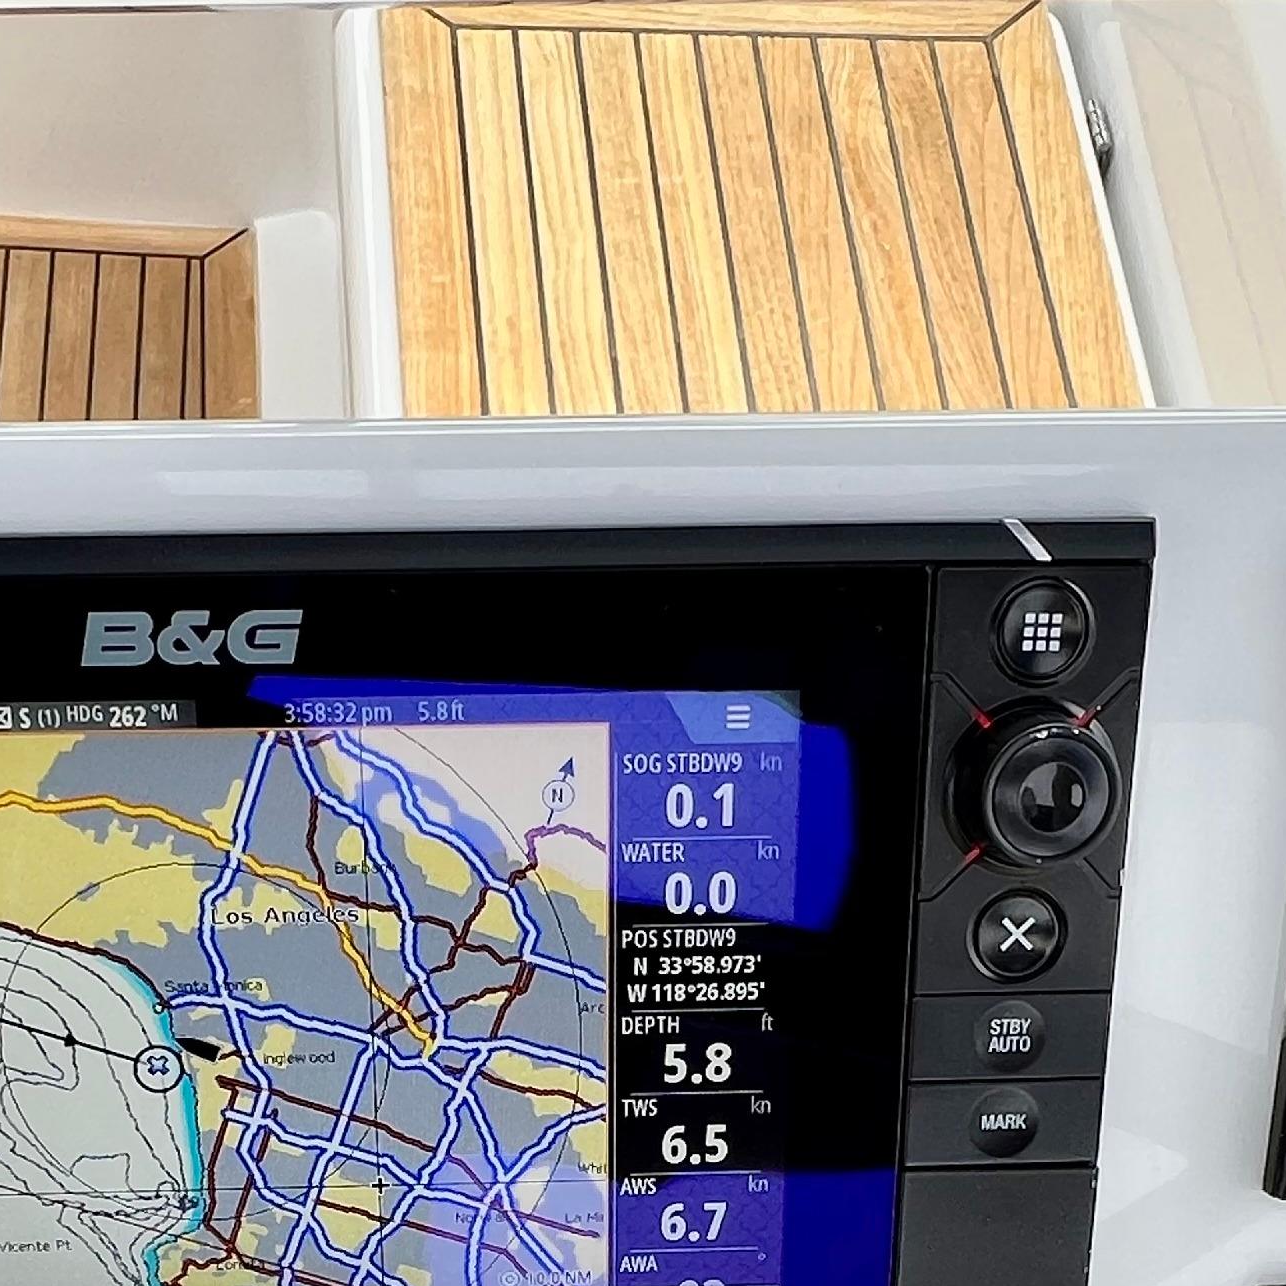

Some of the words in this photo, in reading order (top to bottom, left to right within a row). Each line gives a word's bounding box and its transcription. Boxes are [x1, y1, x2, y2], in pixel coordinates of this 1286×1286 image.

[81, 609, 303, 666] B&G
[18, 707, 31, 729] S
[37, 708, 61, 729] (1)
[66, 705, 104, 723] HDG
[109, 706, 147, 728] 262
[283, 702, 357, 724] 3:58:32
[361, 704, 393, 727] pm
[417, 701, 448, 722] 5.8
[451, 699, 465, 721] ft
[623, 753, 662, 774] SOG
[666, 752, 743, 773] STBDW9
[759, 752, 783, 772] kn
[666, 782, 735, 829] 0.1
[621, 842, 685, 863] WATER
[757, 840, 780, 860] kn
[665, 871, 737, 915] 0.0
[212, 904, 253, 925] Los
[265, 906, 360, 926] Angeles
[621, 929, 658, 949] POS
[663, 927, 737, 948] STBDW9
[633, 957, 648, 976] N
[627, 983, 647, 1003] W
[621, 1016, 681, 1035] DEPTH
[761, 1012, 774, 1031] ft
[989, 1018, 1032, 1037] STBY
[988, 1035, 1032, 1054] AUTO
[664, 1042, 732, 1084] 5.8
[622, 1098, 658, 1118] TWS
[751, 1096, 772, 1114] kn
[981, 1112, 1028, 1132] MARK
[661, 1124, 729, 1164] 6.5
[620, 1177, 657, 1196] AWS
[748, 1175, 770, 1193] kn
[660, 1201, 728, 1242] 6.7
[619, 1255, 658, 1273] AWA
